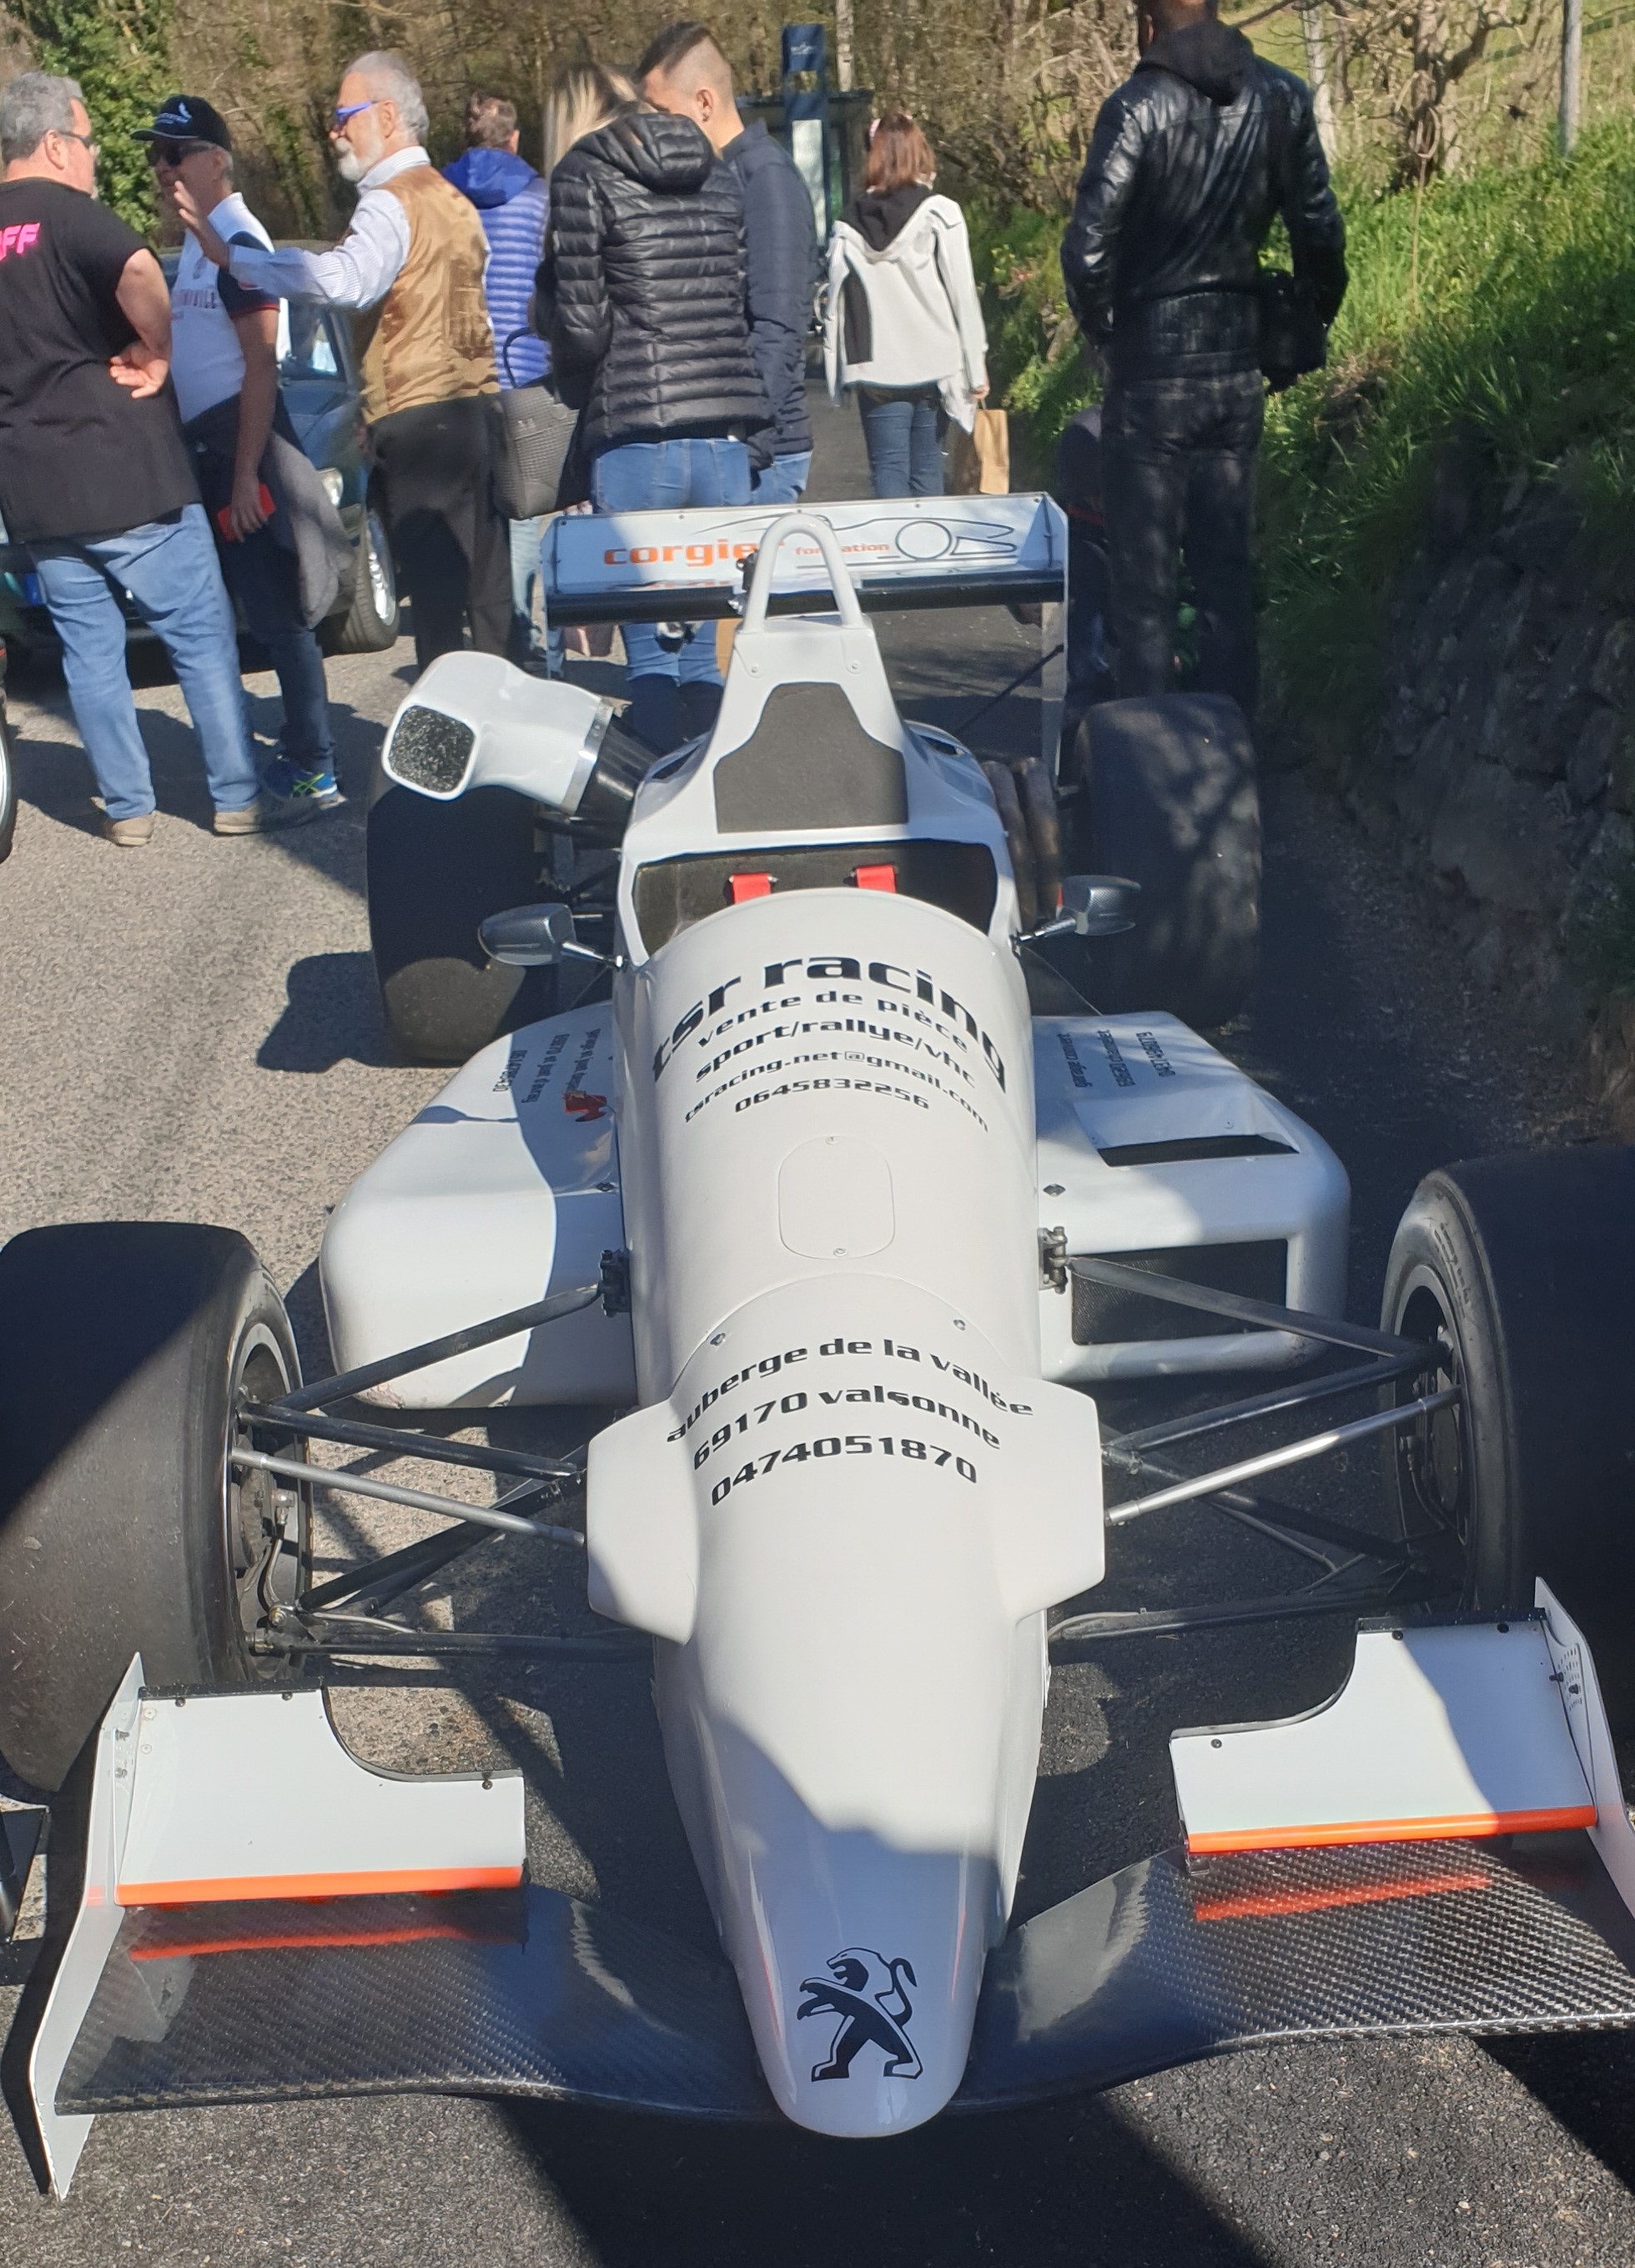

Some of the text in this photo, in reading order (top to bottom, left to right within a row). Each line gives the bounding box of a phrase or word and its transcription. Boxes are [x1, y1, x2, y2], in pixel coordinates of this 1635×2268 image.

[0, 223, 40, 261] FF
[604, 538, 888, 567] corgie foration
[652, 976, 741, 1082] tsr
[764, 957, 1006, 1094] racing
[696, 1018, 975, 1089] sport/rallye/vhc
[698, 991, 968, 1054] vente de pièce
[735, 1079, 929, 1114] 0645832256
[667, 1338, 1033, 1442] auberge de la vallée
[694, 1385, 1000, 1471] 69170 valsonne
[712, 1436, 977, 1506] 0474051870
